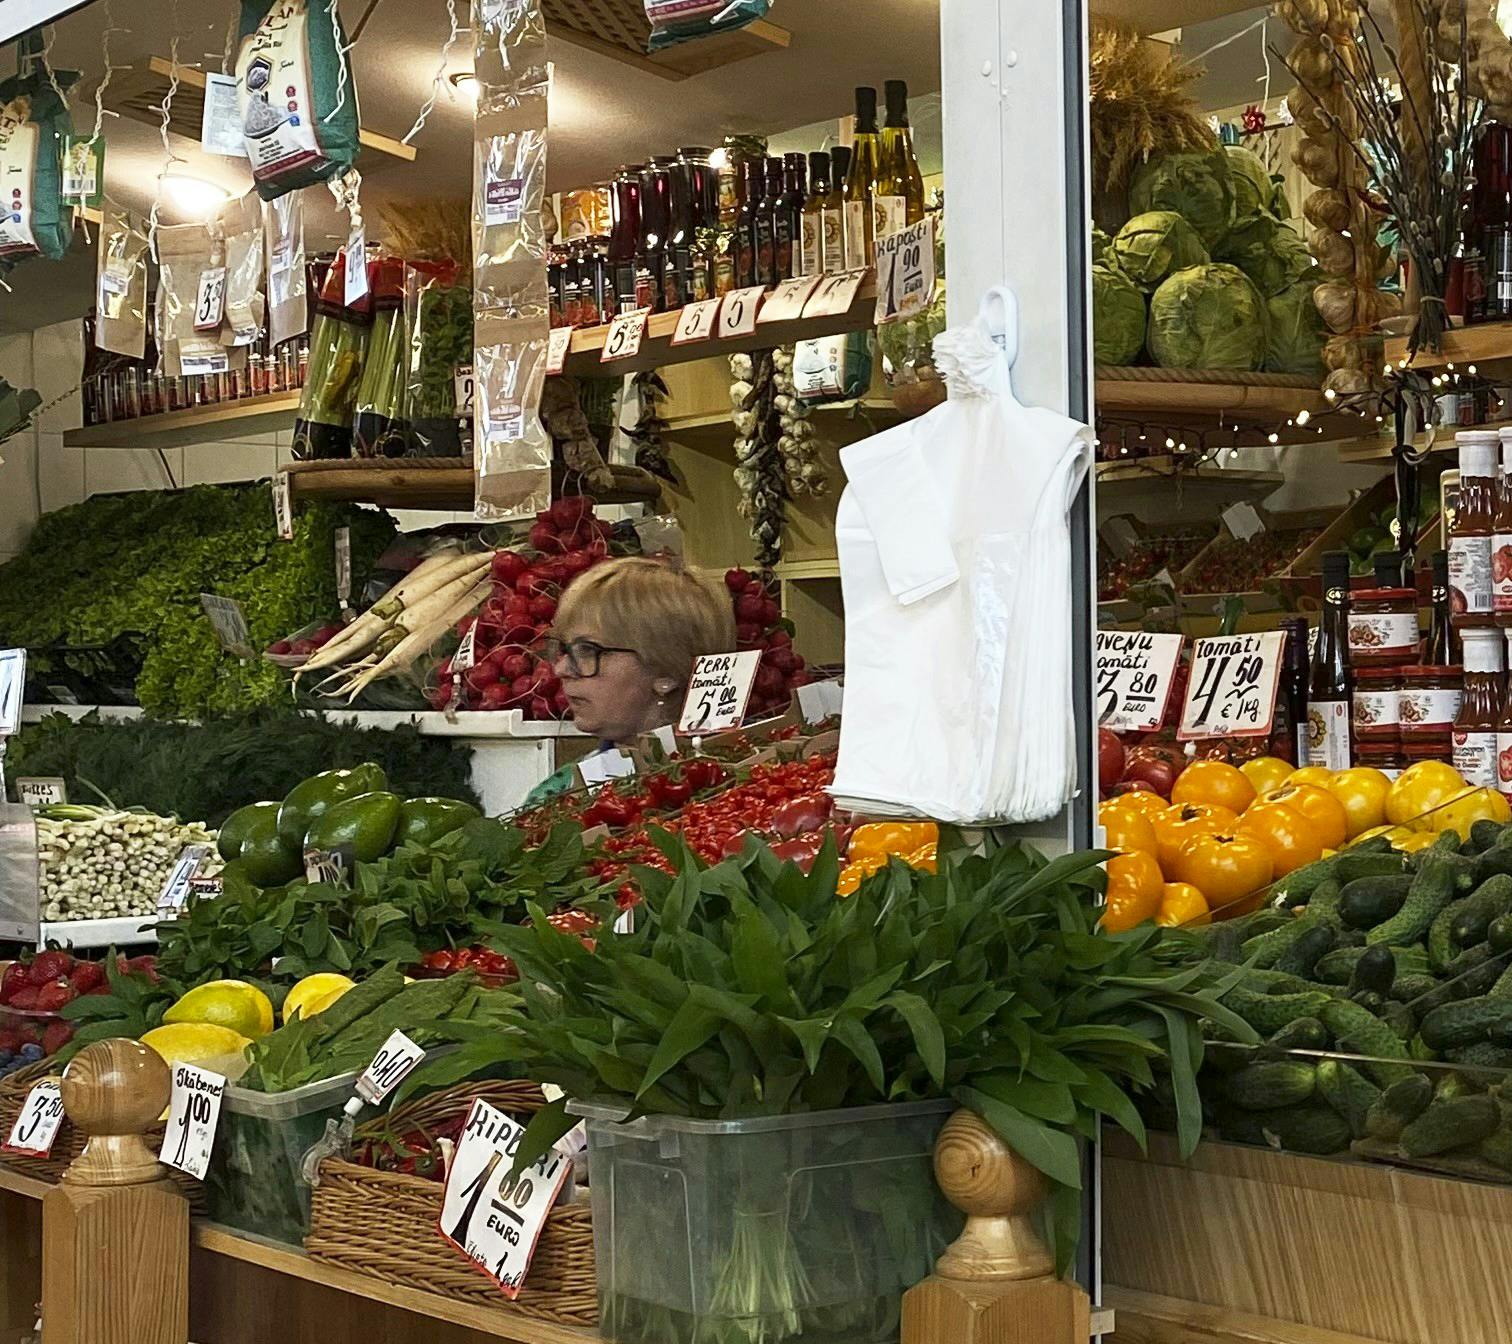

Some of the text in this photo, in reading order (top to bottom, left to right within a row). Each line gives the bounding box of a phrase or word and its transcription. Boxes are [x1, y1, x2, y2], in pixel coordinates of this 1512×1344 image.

[902, 245, 920, 273] 90
[200, 282, 211, 322] 3
[885, 253, 897, 317] 1
[727, 293, 745, 329] 5
[608, 324, 625, 354] 5
[1096, 655, 1149, 671] omāti
[1197, 637, 1261, 659] tomāti
[1129, 672, 1158, 694] 80
[1232, 656, 1264, 686] 50
[688, 688, 717, 731] 5
[1096, 669, 1120, 726] 3
[1192, 657, 1232, 728] 4
[372, 1048, 414, 1088] 0,40
[18, 1095, 48, 1143] 3
[193, 1093, 211, 1125] 00
[173, 1093, 193, 1168] 1
[449, 1149, 503, 1249] 1
[498, 1167, 534, 1210] 00
[486, 1213, 520, 1248] EURO
